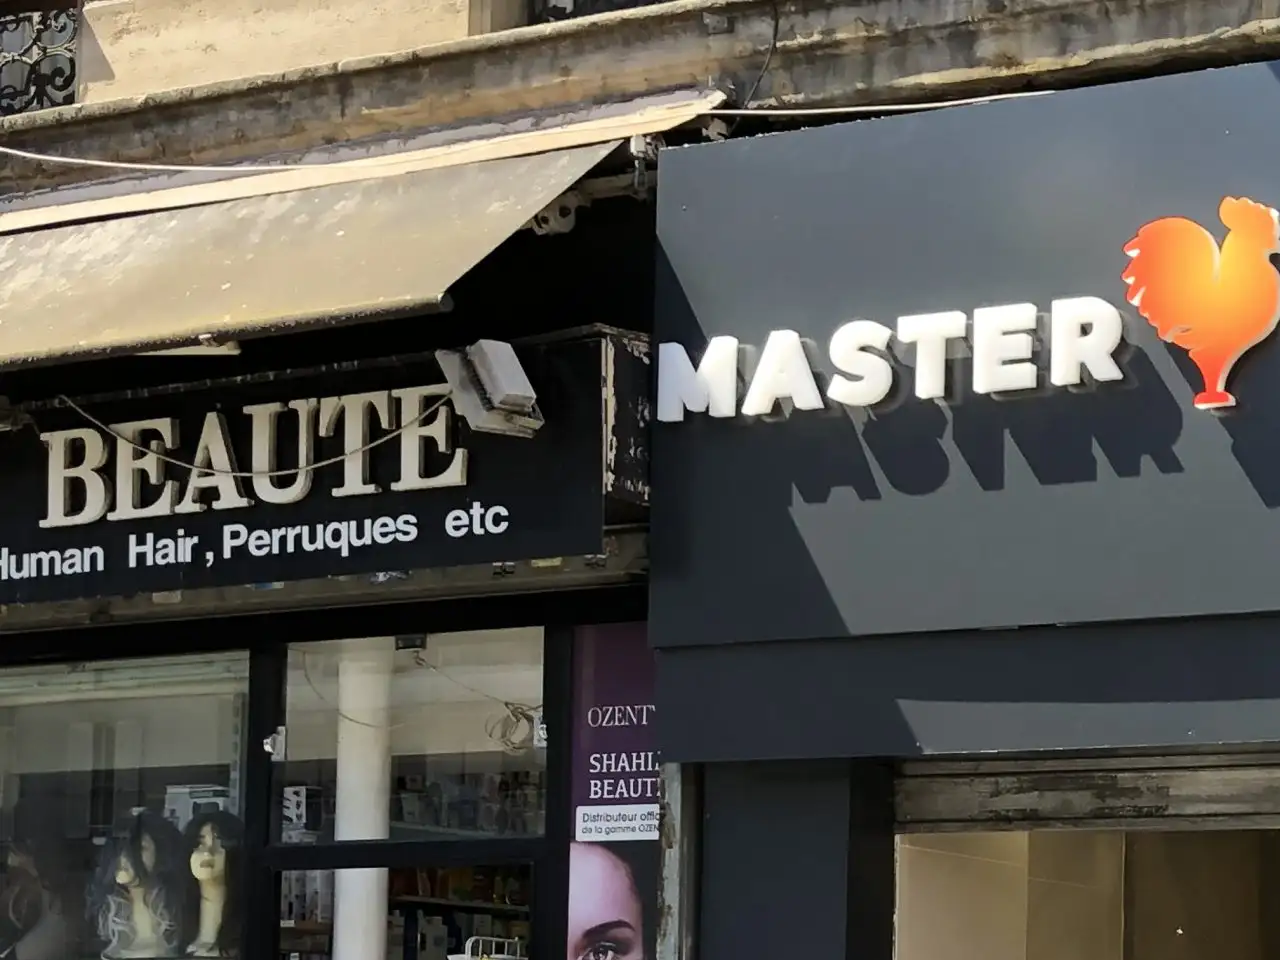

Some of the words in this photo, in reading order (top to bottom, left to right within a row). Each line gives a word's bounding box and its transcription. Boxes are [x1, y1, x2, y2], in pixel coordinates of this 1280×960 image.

[656, 296, 1124, 422] MASTER
[37, 382, 469, 529] BEAUTE
[222, 511, 418, 561] Perruques
[445, 501, 510, 538] etc
[587, 704, 656, 728] OZENT
[588, 751, 661, 774] SHAHI
[582, 812, 637, 823] Distributeur
